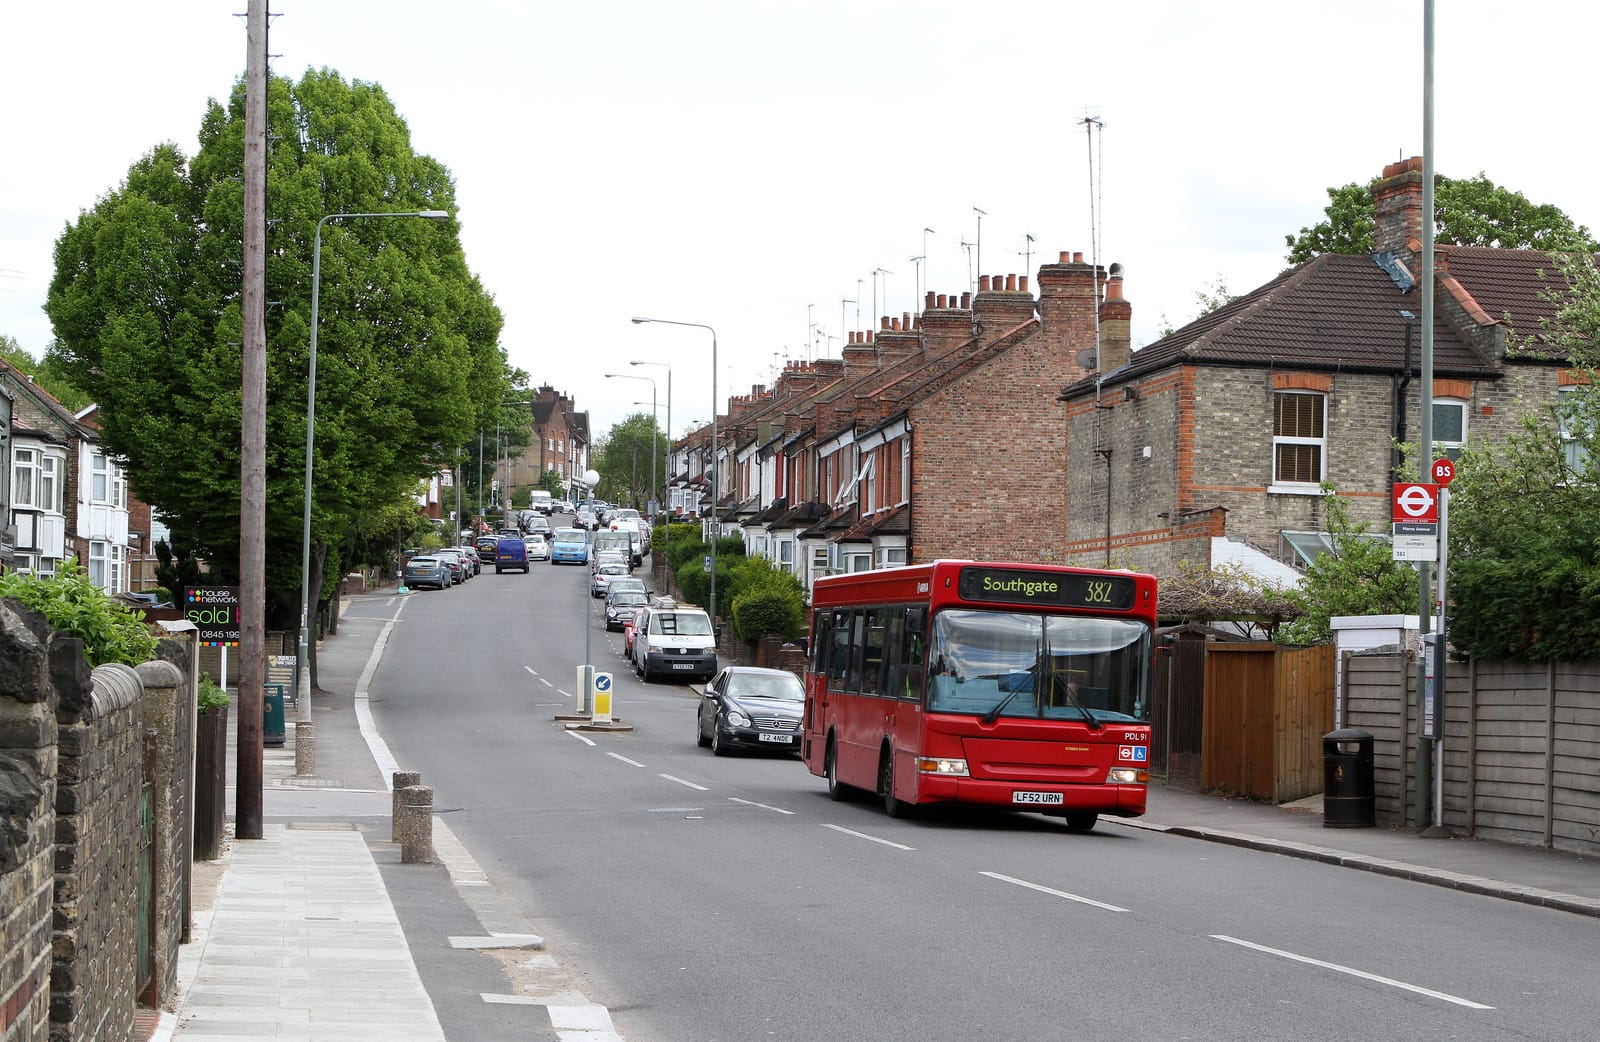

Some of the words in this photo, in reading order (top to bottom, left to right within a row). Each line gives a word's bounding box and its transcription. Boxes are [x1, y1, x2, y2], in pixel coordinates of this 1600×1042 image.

[1436, 466, 1451, 477] BS
[983, 576, 1058, 596] Southgate
[1084, 580, 1113, 603] 382
[201, 589, 230, 597] house
[201, 596, 238, 604] network
[188, 606, 230, 624] sold
[201, 630, 224, 639] 0845
[1124, 732, 1139, 741] PDL
[1016, 792, 1040, 802] LF52
[1042, 793, 1060, 803] URN
